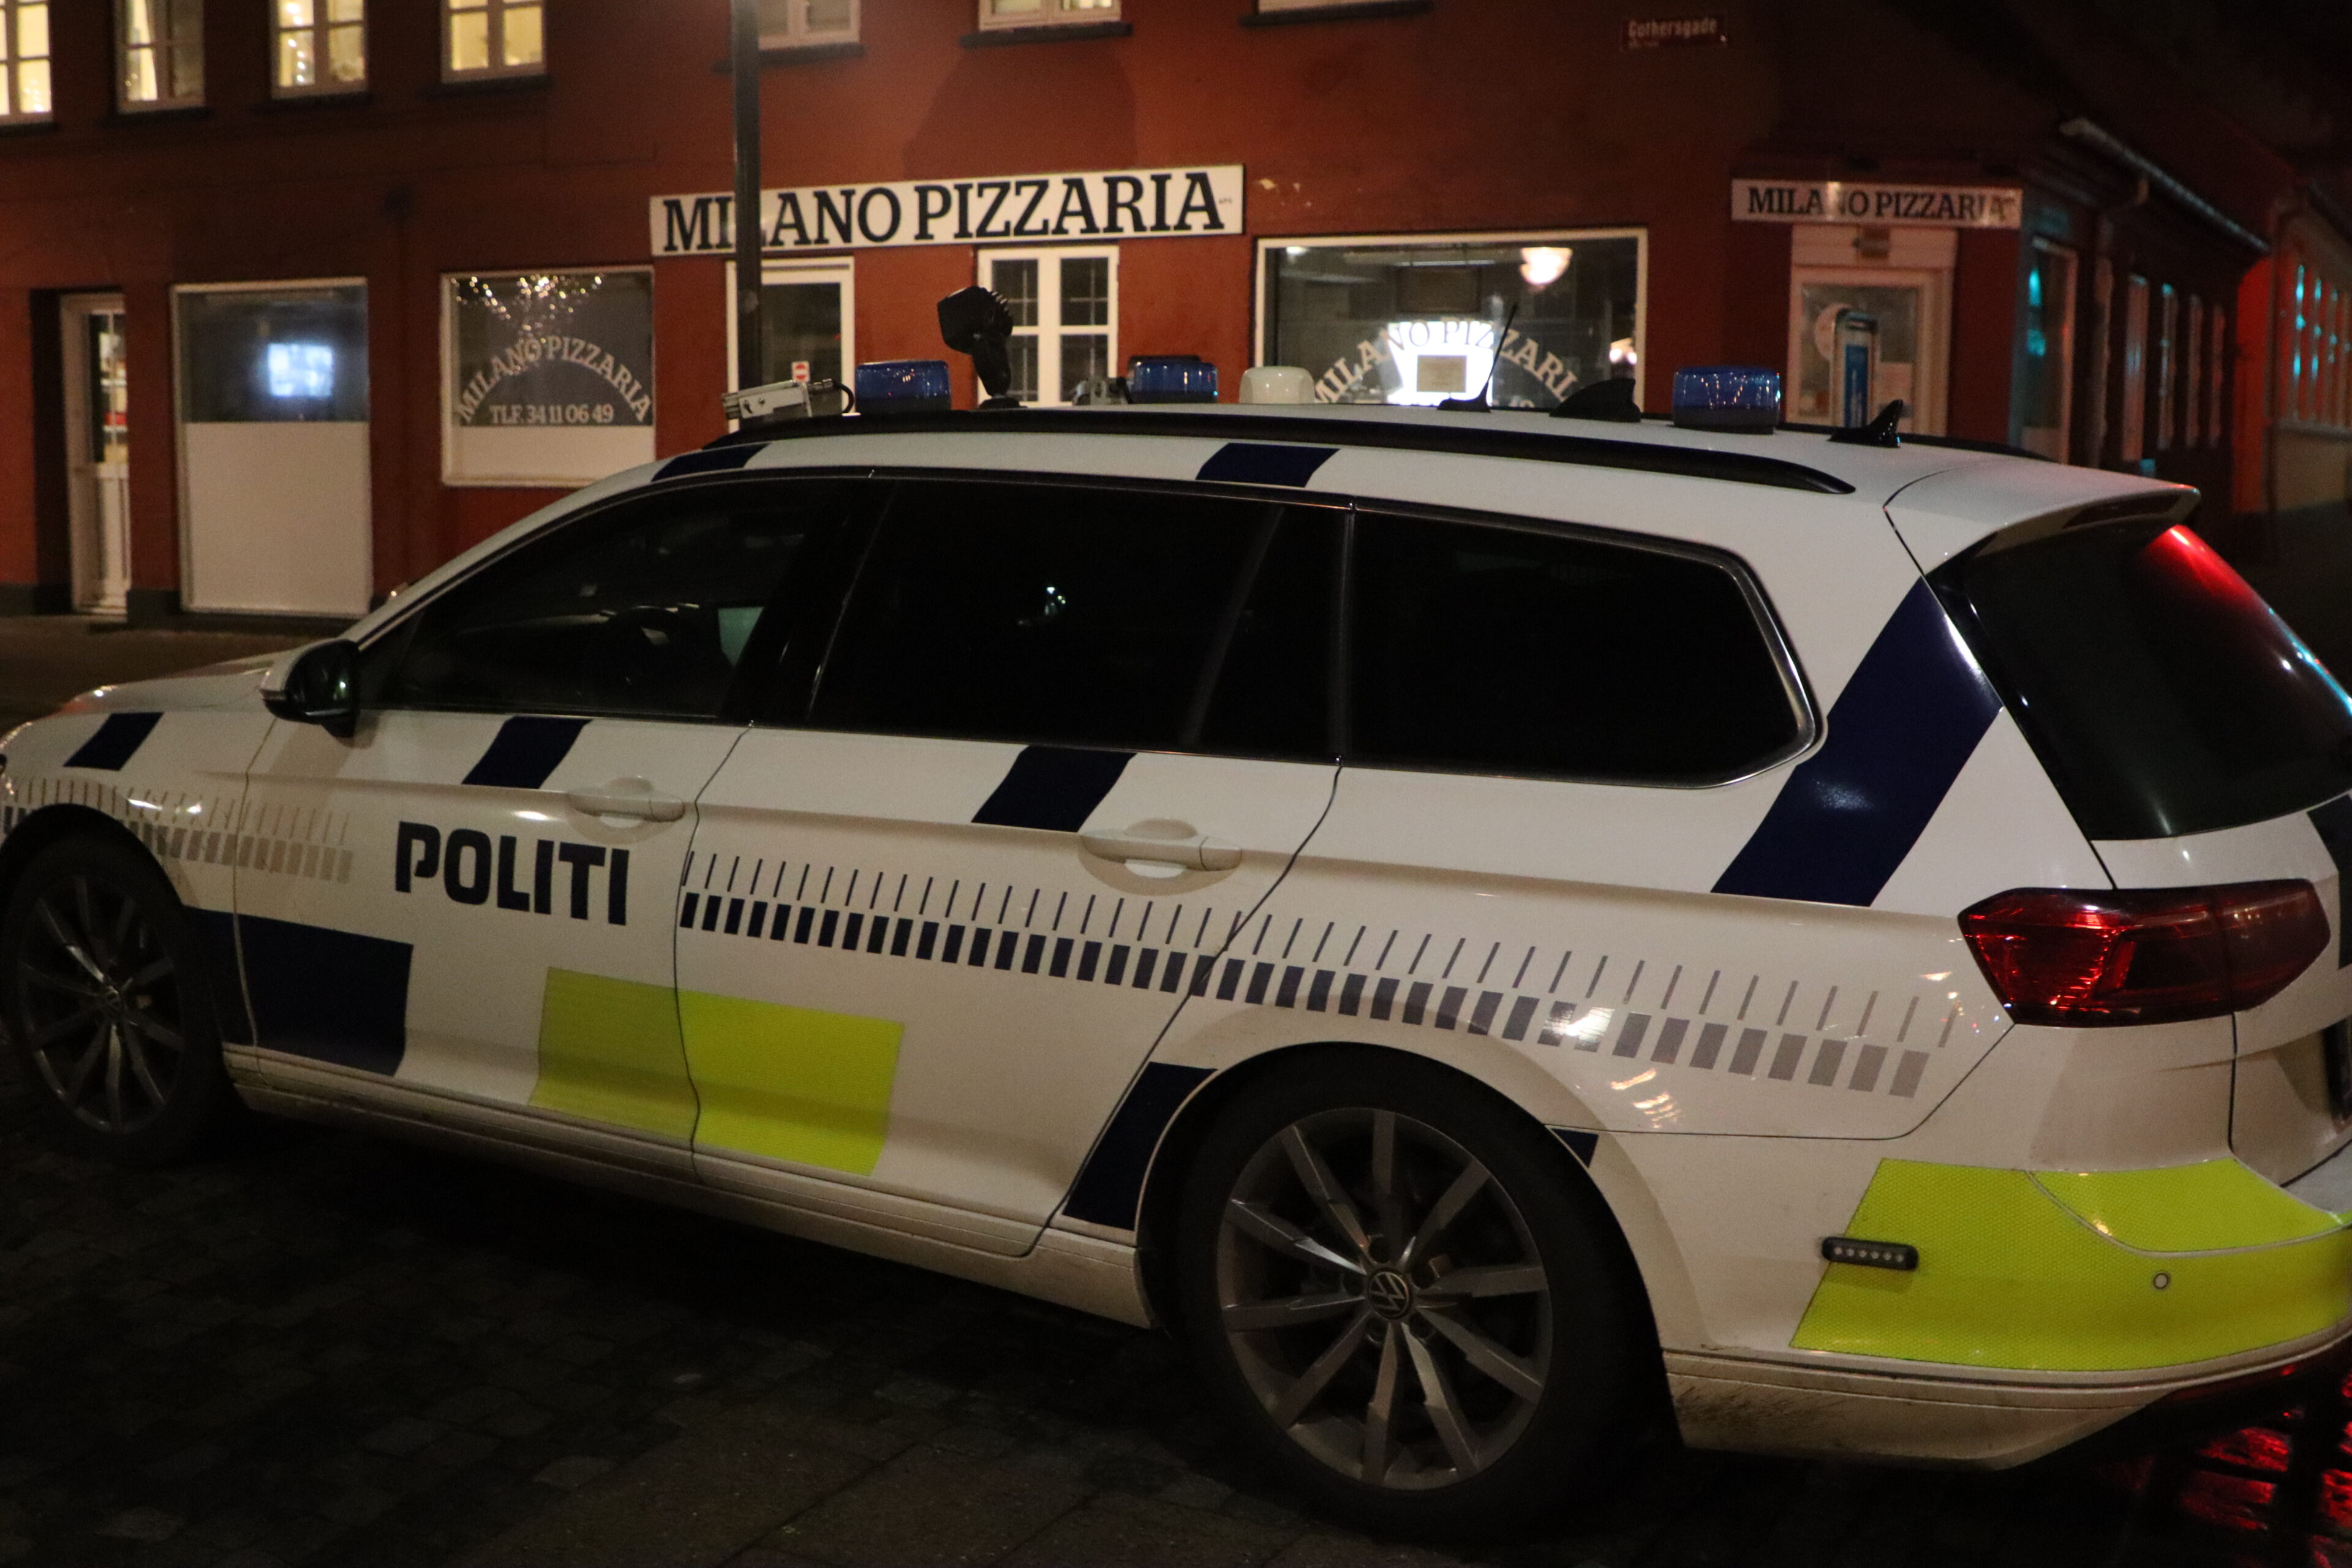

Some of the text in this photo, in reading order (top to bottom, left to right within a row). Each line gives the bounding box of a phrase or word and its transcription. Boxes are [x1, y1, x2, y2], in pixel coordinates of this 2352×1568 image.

[1628, 17, 1717, 38] Gothersgade
[663, 172, 1224, 252] MIANO PIZZARIA
[457, 336, 652, 423] MILANO PIZZARIA
[1441, 317, 1579, 403] PIZZARI
[395, 821, 630, 925] POLITI
